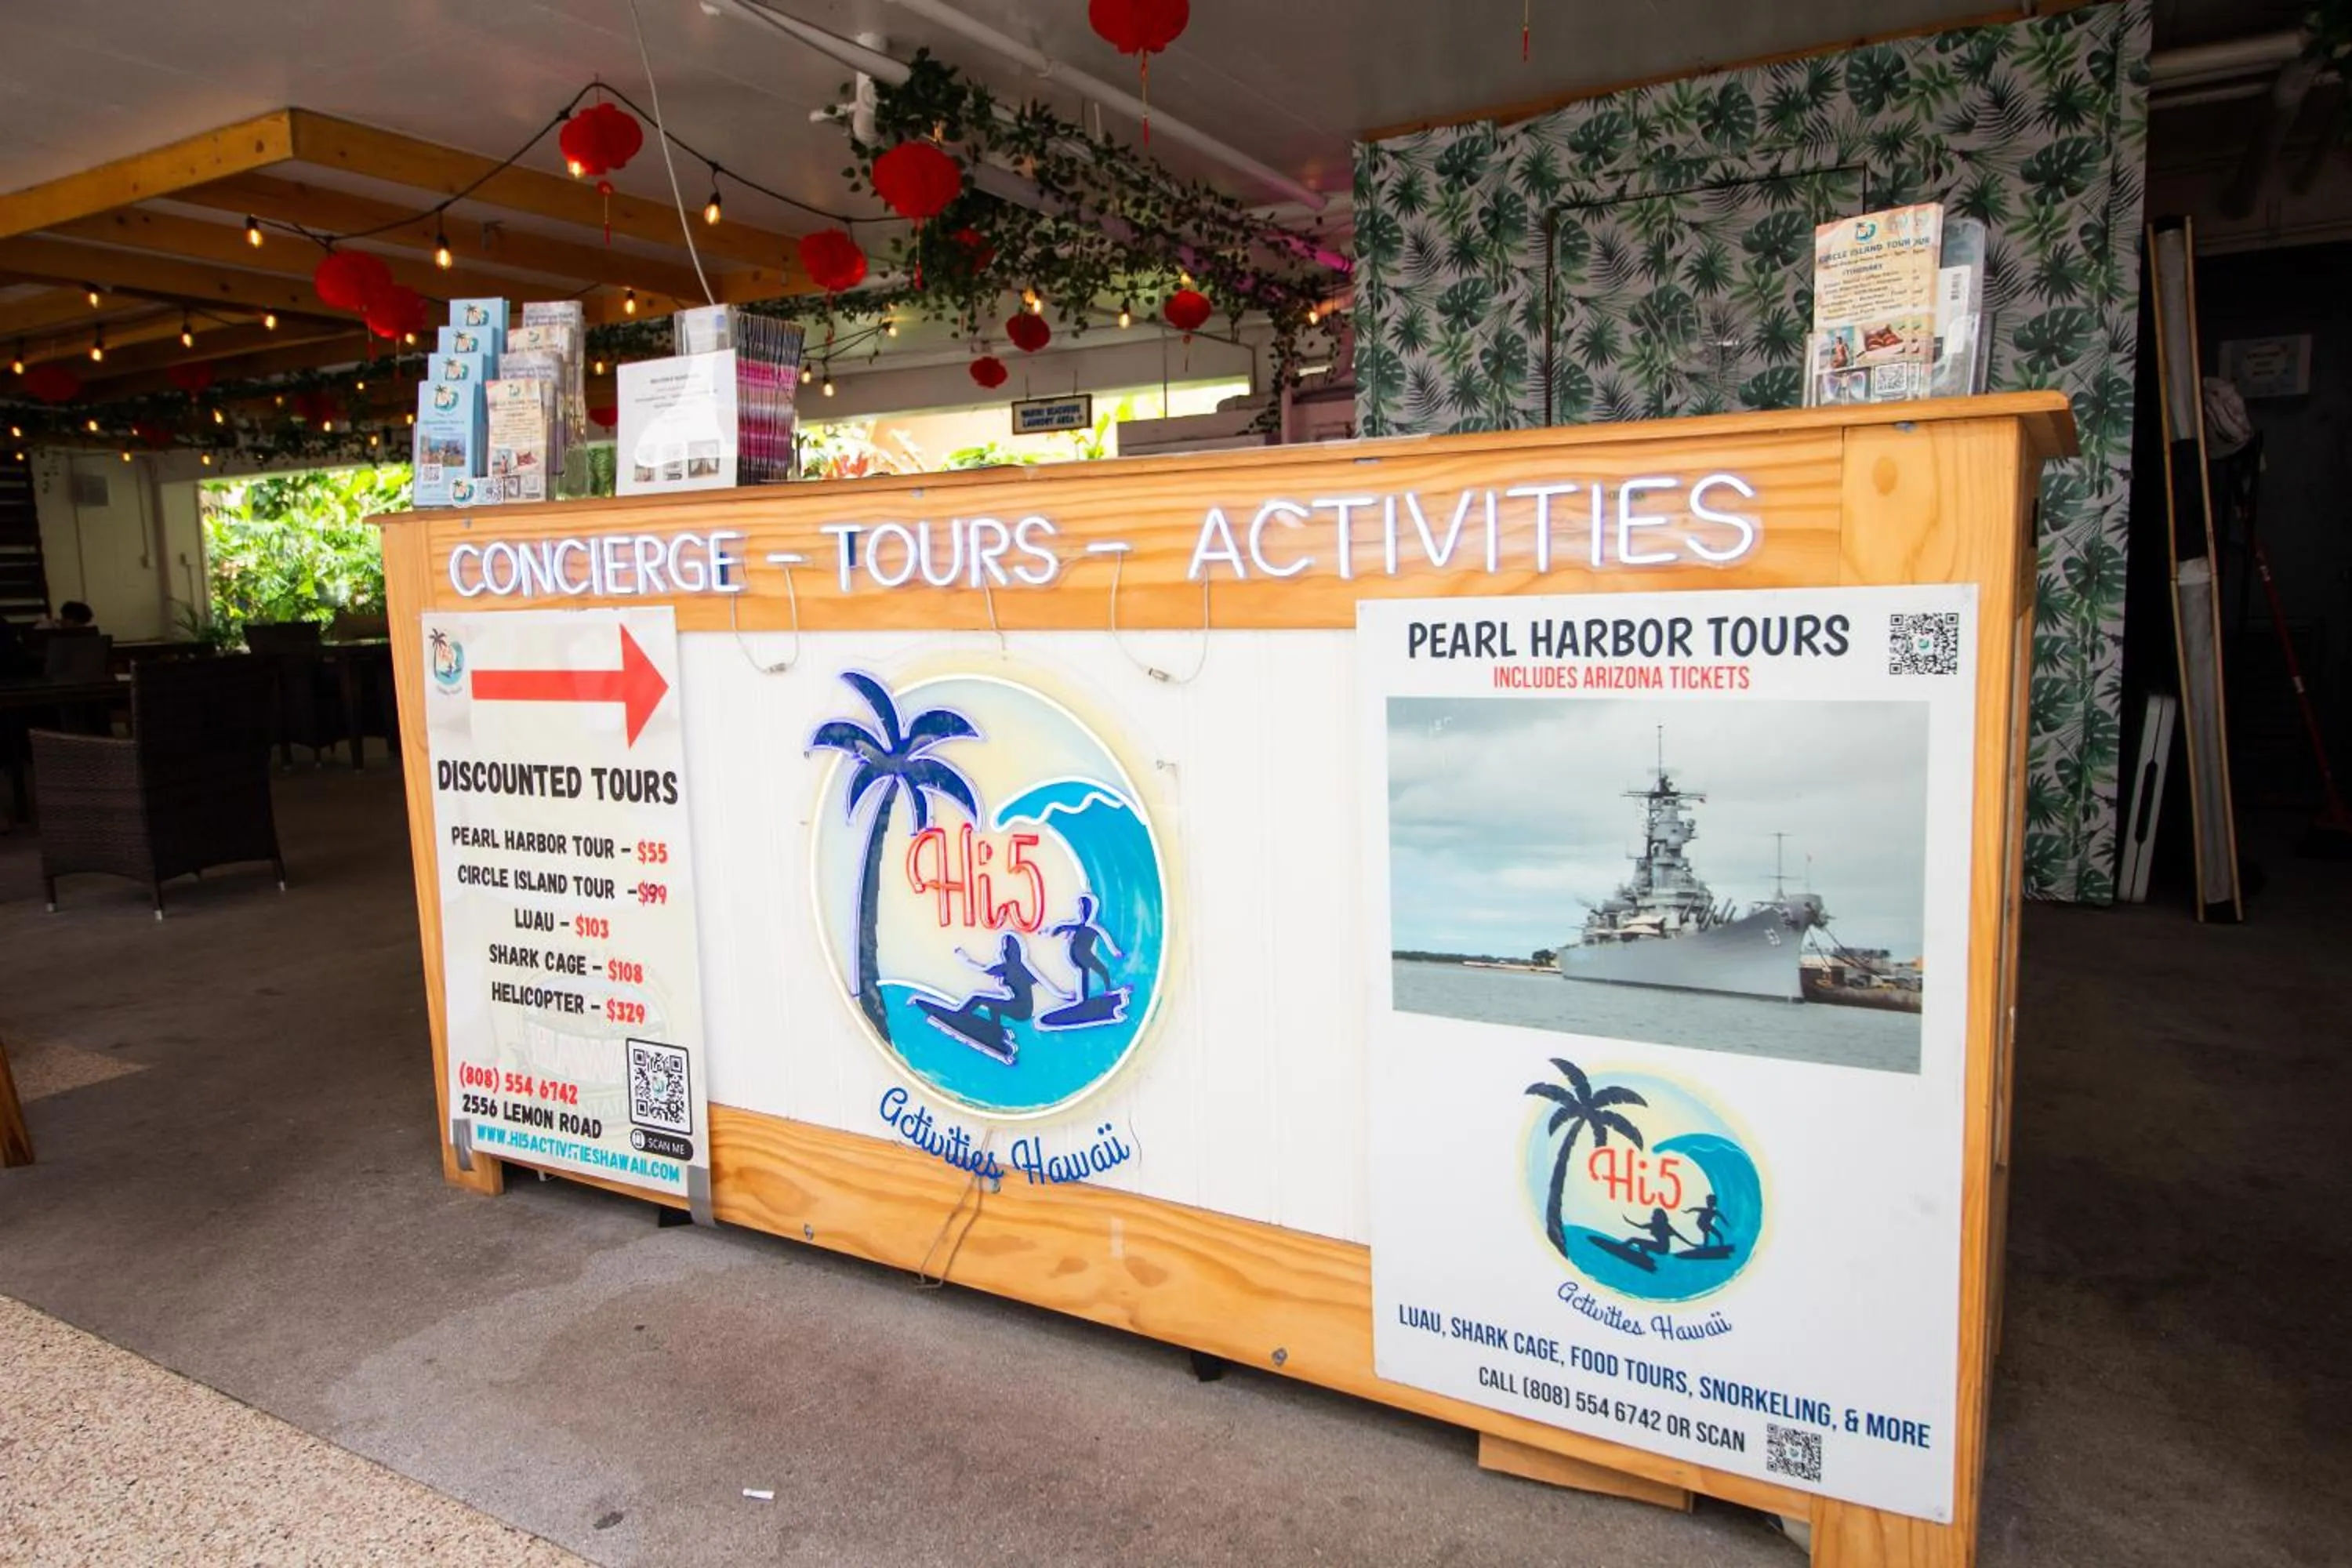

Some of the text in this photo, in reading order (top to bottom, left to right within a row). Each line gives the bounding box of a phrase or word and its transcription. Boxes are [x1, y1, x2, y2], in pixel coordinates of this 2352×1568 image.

[1849, 244, 1883, 256] ISLAND
[448, 531, 746, 597] CONCIERGE
[821, 516, 1060, 593] TOURS
[1188, 474, 1756, 580] ACTIVITIES
[1409, 614, 1851, 659] PEARL HARBOR TOURS
[1494, 666, 1750, 689] INCLUDES ARIZONA TICKETS
[437, 760, 678, 805] DISCOUNTED TOURS
[452, 826, 499, 849] PEARL
[505, 830, 568, 855] HARBOR
[573, 836, 615, 858] TOUR
[637, 838, 669, 864] $55
[458, 865, 509, 888] CIRCLE
[514, 869, 568, 894] ISLAND
[573, 876, 615, 899] TOUR
[906, 822, 1045, 932] Hi5
[514, 908, 554, 931] LUAU
[575, 914, 609, 939] $103
[489, 943, 539, 968] SHARK
[545, 951, 586, 976] CAGE
[608, 958, 644, 984] $108
[492, 982, 584, 1014] HELICOPTER
[606, 997, 645, 1024] $329
[459, 1061, 578, 1105] (808) 554 6742
[463, 1094, 498, 1117] 2556
[503, 1101, 554, 1130] LEMON
[559, 1112, 602, 1138] ROAD
[880, 1087, 1130, 1185] Activities Hawaii
[647, 1138, 685, 1155] SCAN ME
[1588, 1147, 1682, 1210] Hi5
[1557, 1282, 1732, 1341] Activities Hawaii
[1399, 1304, 1931, 1450] LUAU, SHARK CAGE, FOOD TOURS, SNORKELING, & MORE
[1479, 1367, 1745, 1453] CALL (808) 554 6742 OR SCAN
